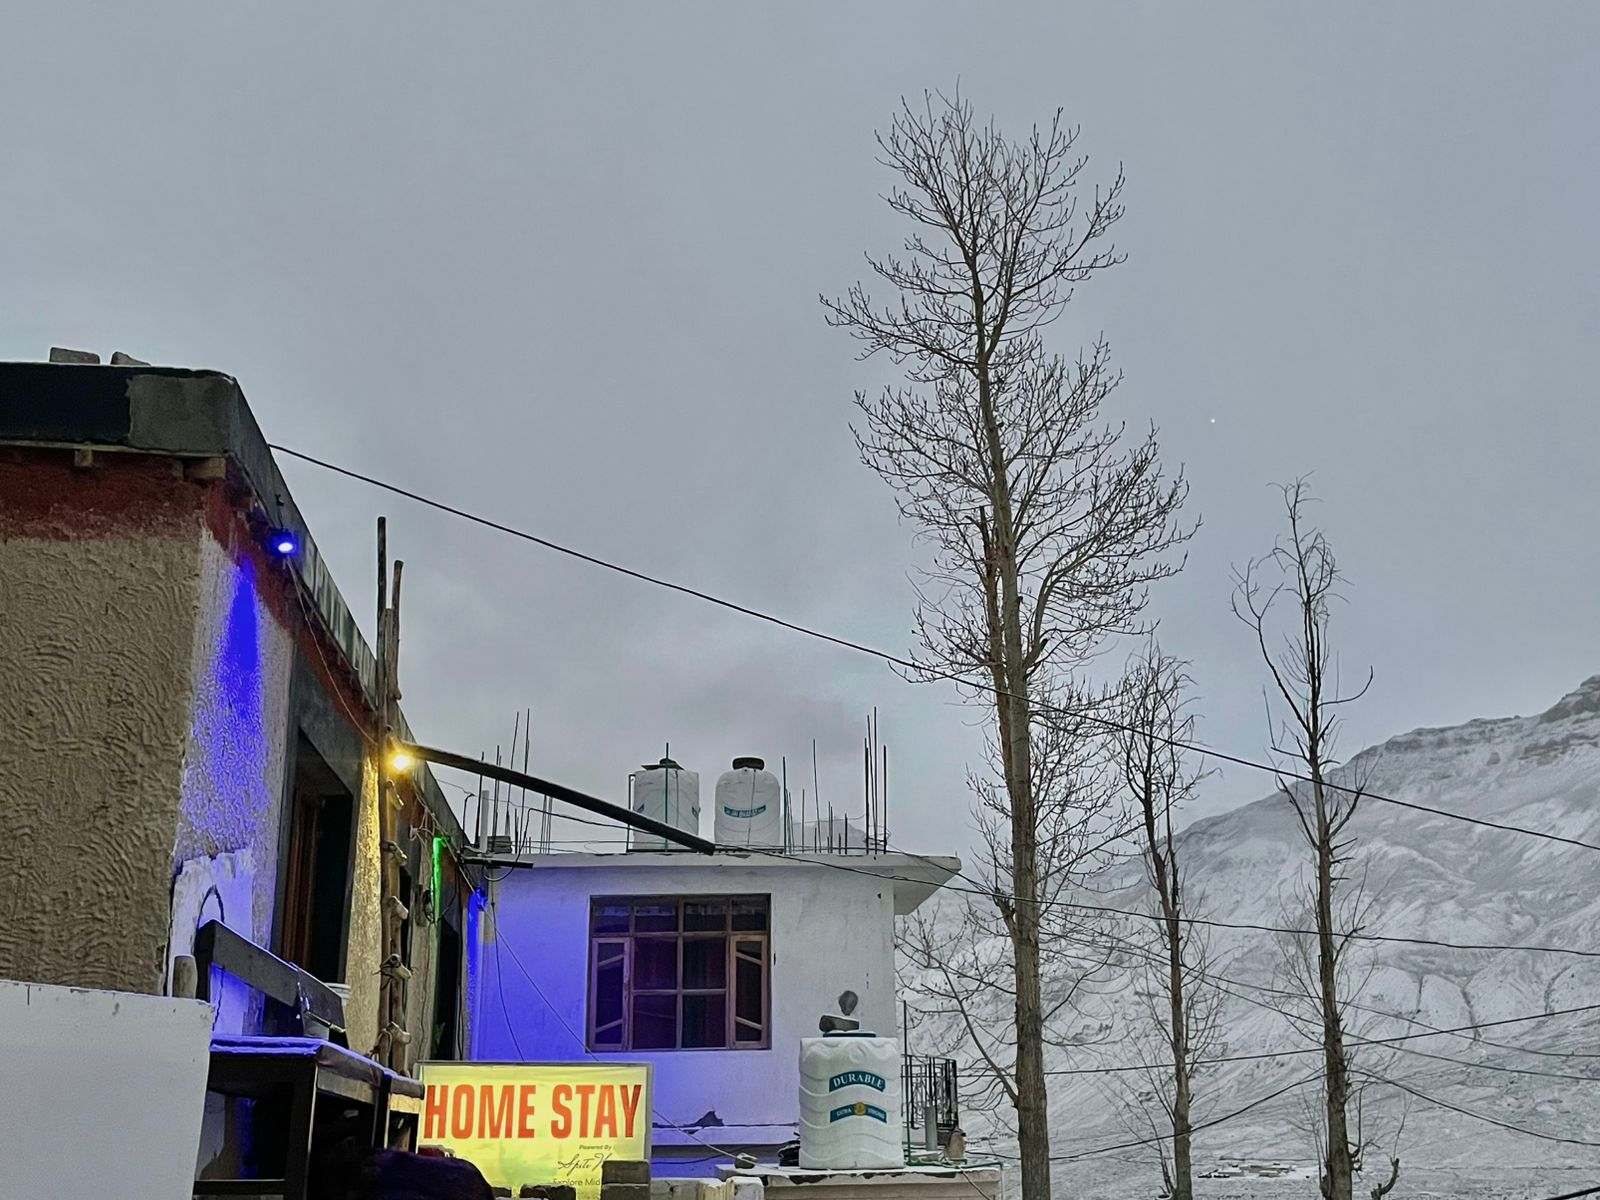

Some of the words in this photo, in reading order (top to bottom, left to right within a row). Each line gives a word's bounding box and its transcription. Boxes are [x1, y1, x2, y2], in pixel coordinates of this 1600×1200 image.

[833, 1073, 884, 1089] DURABLE
[423, 1084, 537, 1140] HOME
[550, 1083, 642, 1139] STAY
